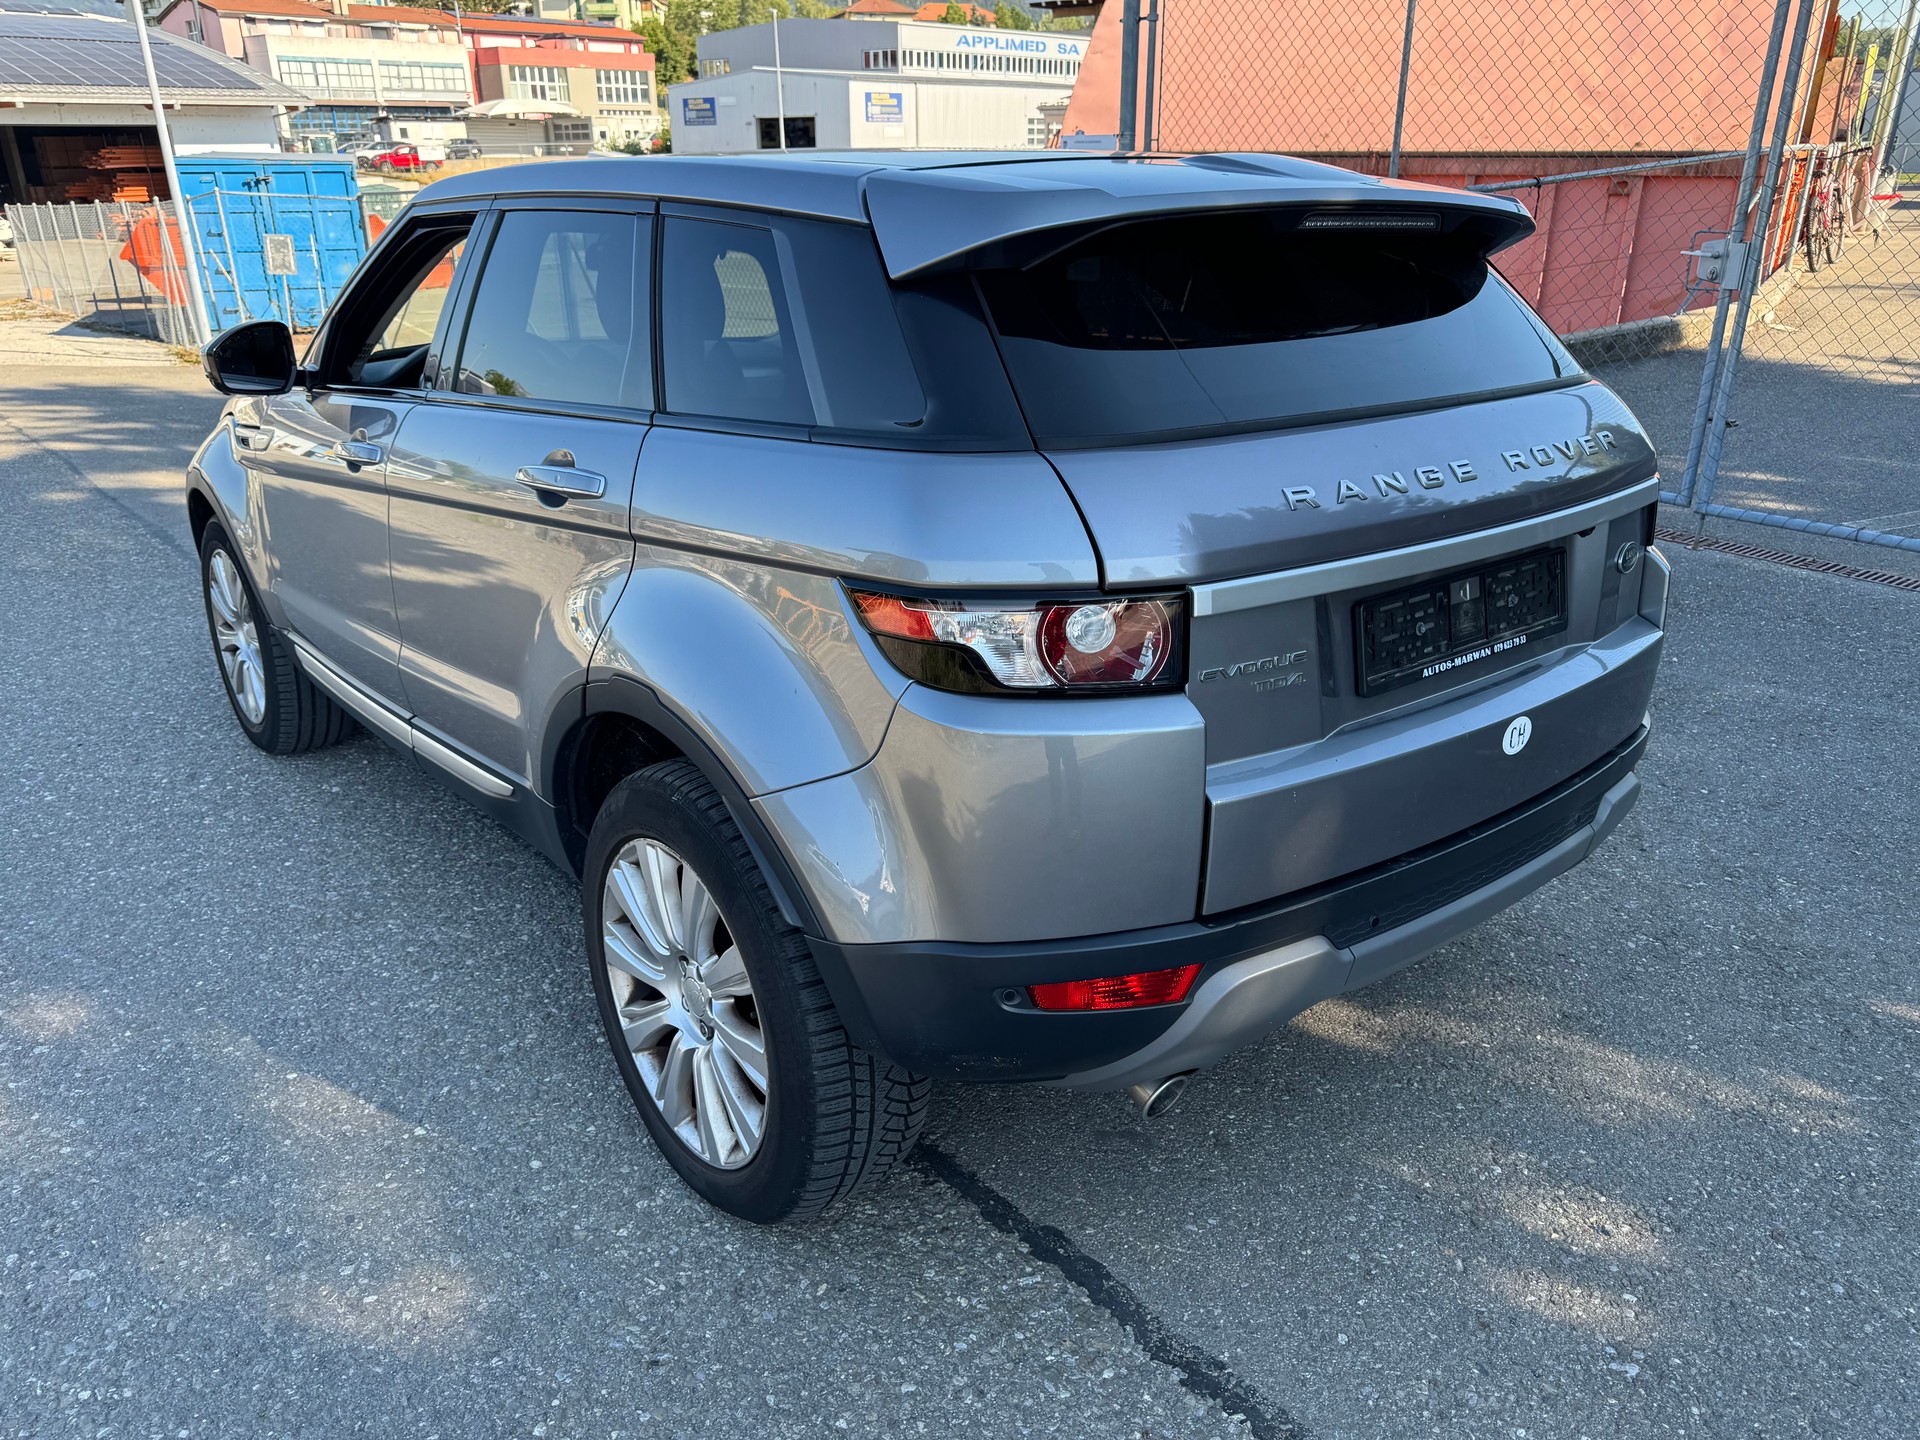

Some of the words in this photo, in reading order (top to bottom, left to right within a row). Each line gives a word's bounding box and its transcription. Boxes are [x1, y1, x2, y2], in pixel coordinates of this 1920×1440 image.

[956, 34, 1047, 53] APPLIMED
[1057, 43, 1080, 55] SA
[1281, 458, 1479, 511] RANGE
[1501, 430, 1618, 472] ROVER
[1198, 650, 1307, 683] EVOQUE
[1422, 647, 1492, 678] AUTOS-MARWAN
[1493, 643, 1504, 654] 079
[1509, 722, 1527, 749] CH
